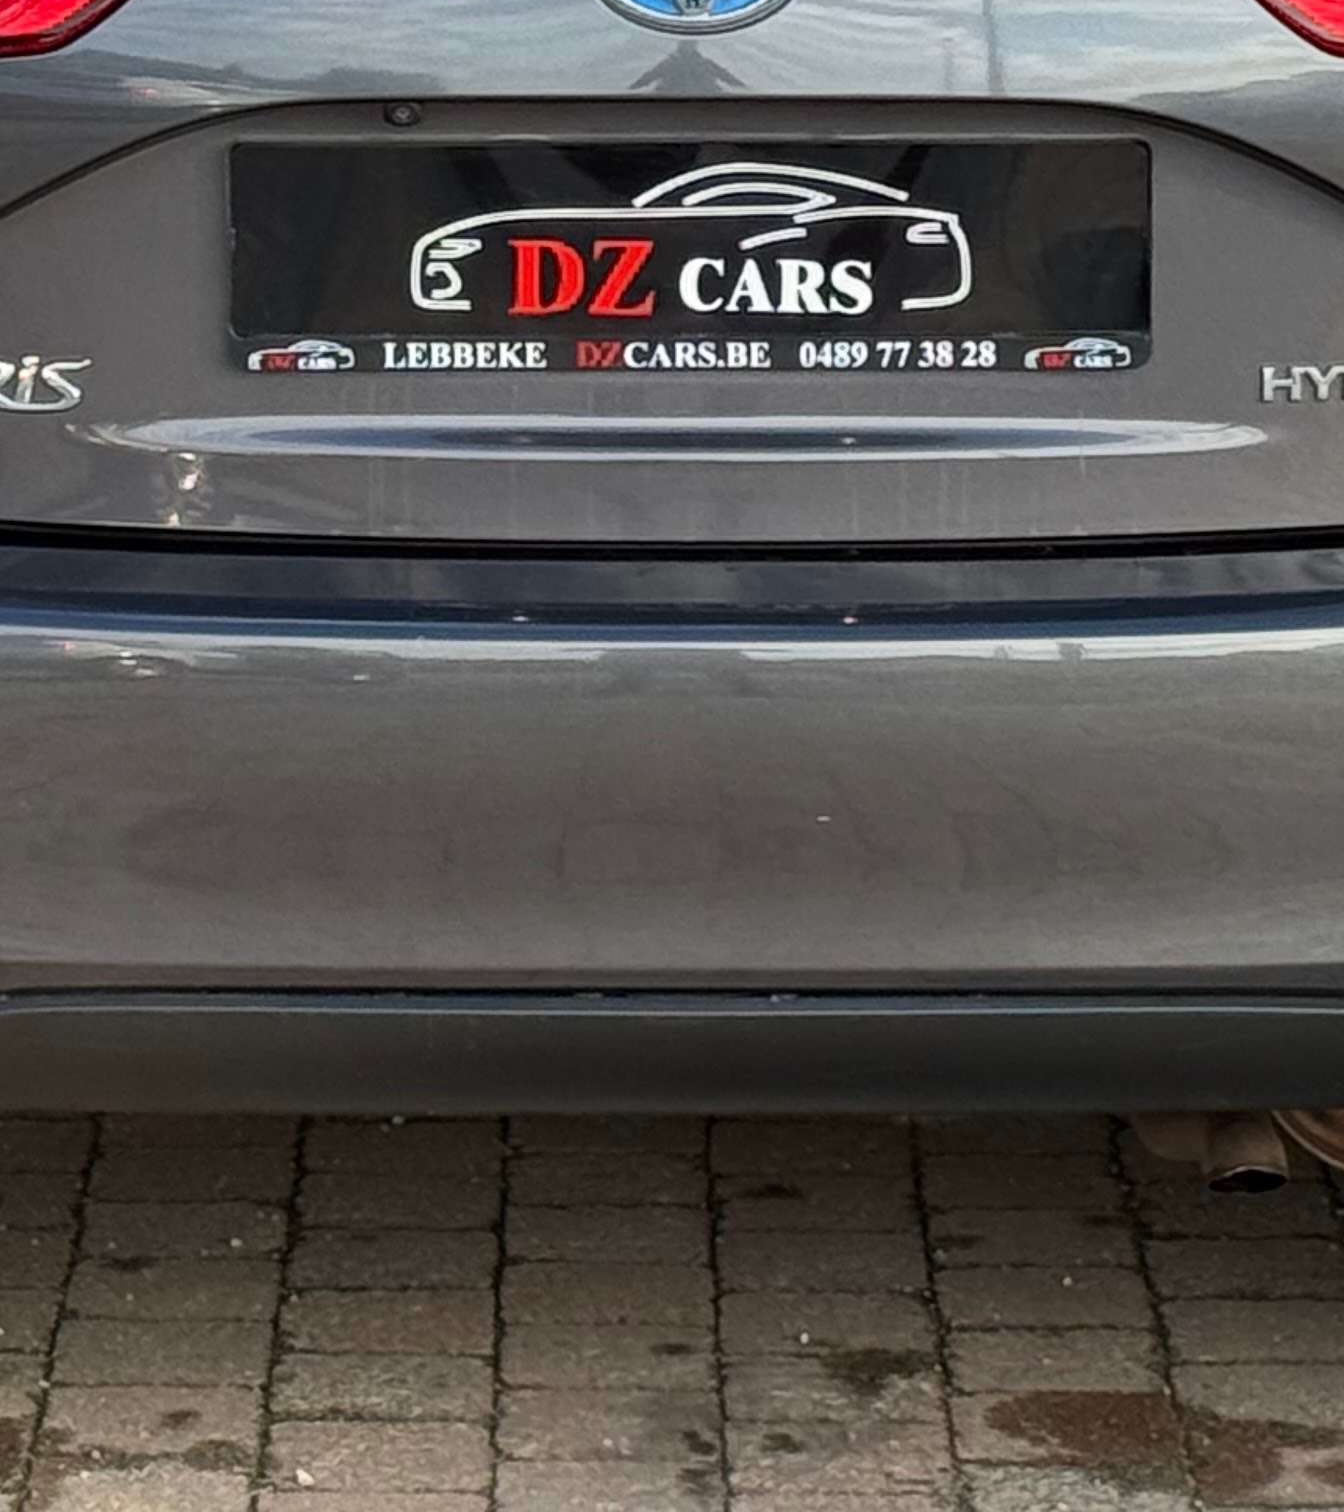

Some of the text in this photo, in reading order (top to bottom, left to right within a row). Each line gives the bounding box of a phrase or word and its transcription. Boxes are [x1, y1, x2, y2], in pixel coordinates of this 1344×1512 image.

[508, 239, 873, 316] DZ CARS
[383, 340, 997, 369] LEBBEKE DZCARS.BE 0489 77 38 28
